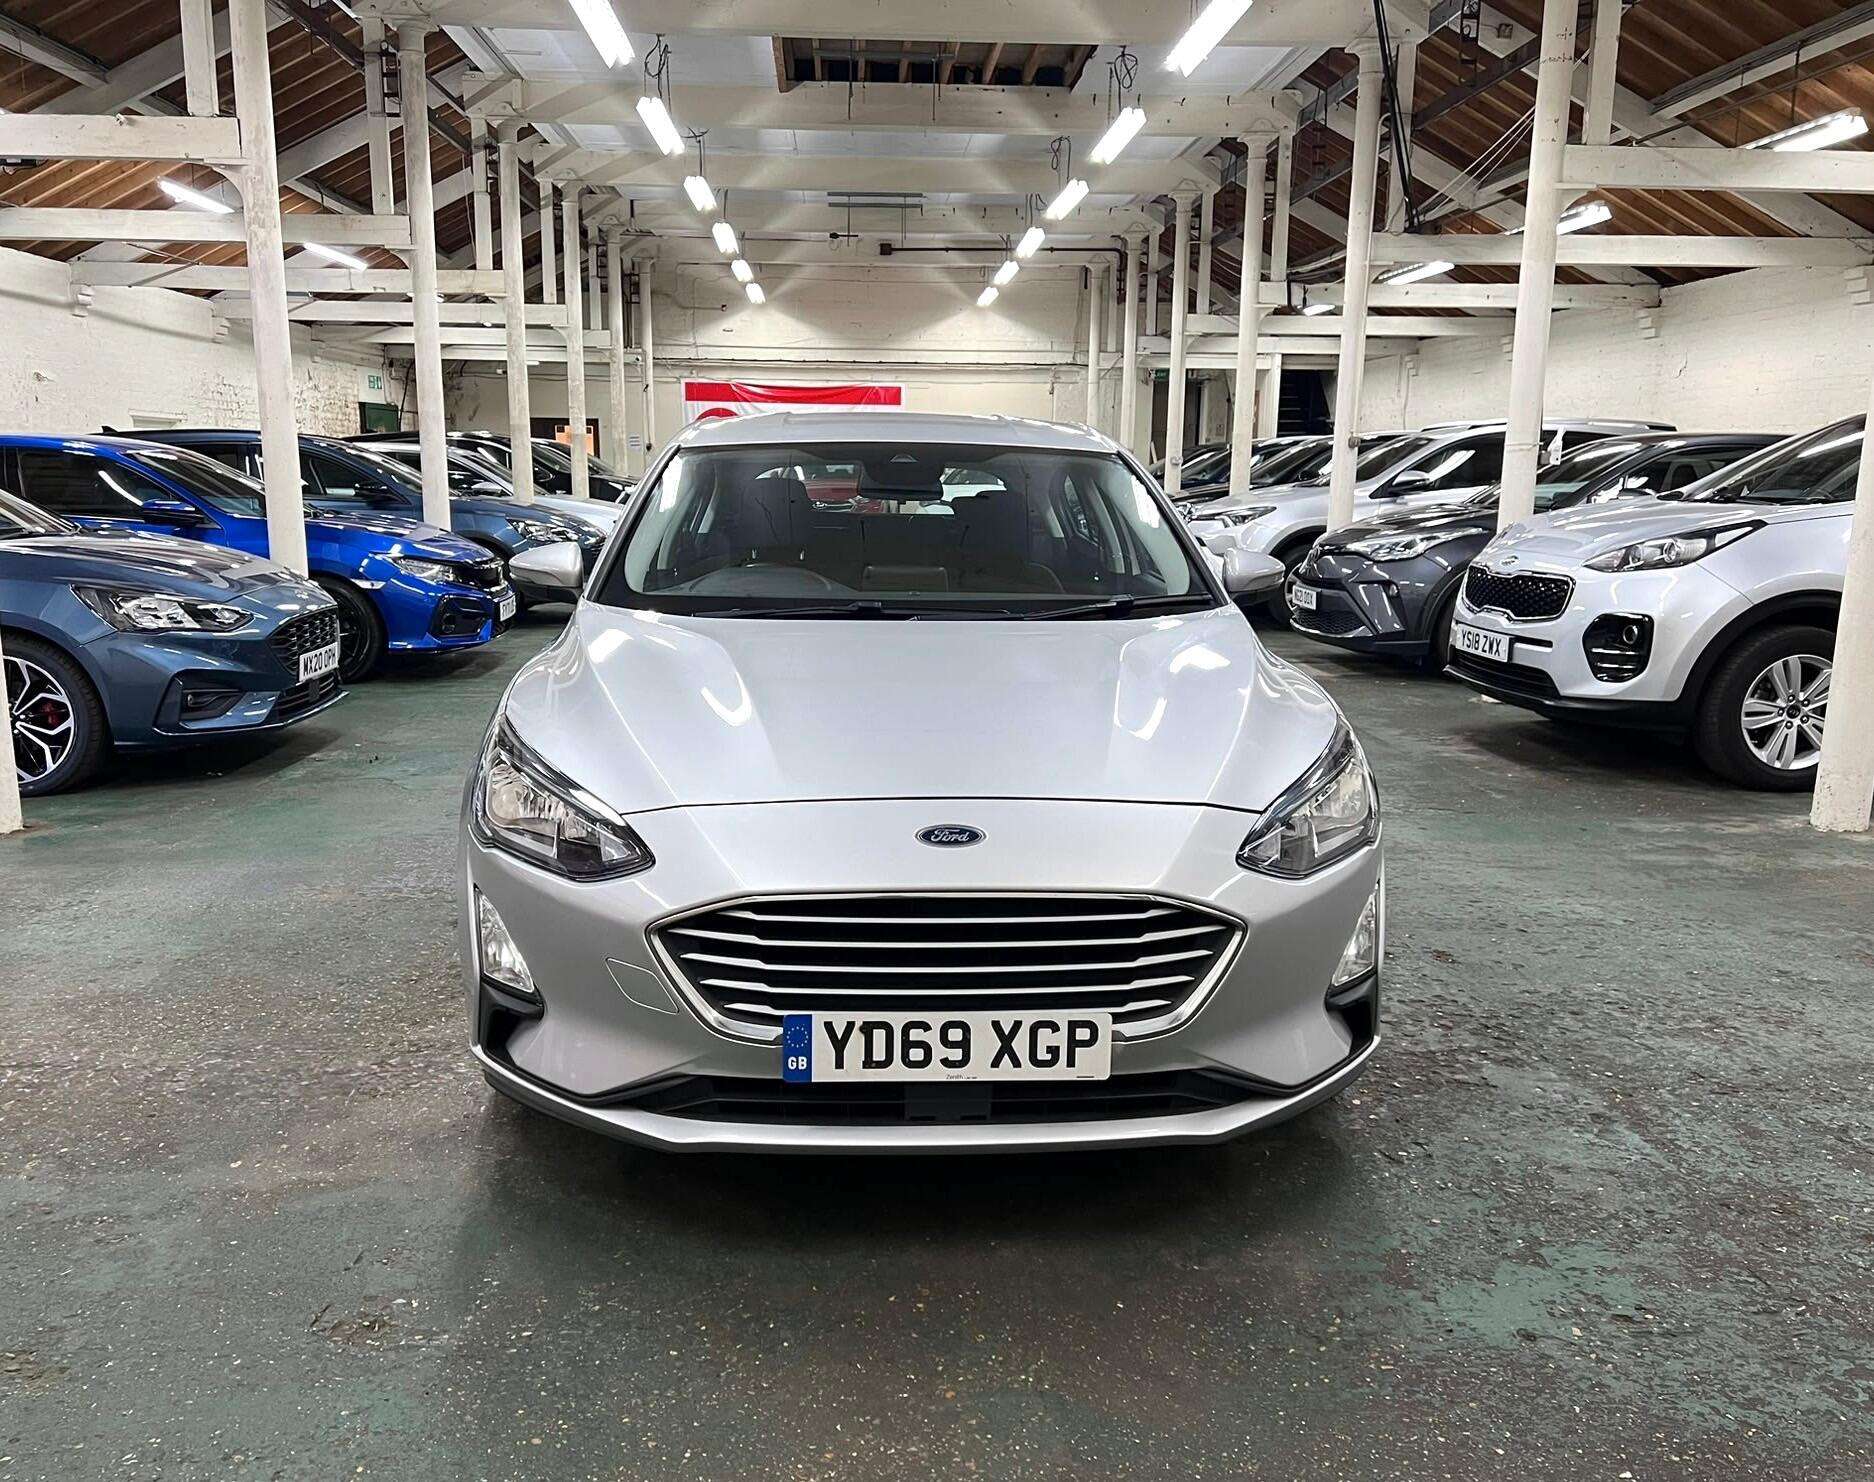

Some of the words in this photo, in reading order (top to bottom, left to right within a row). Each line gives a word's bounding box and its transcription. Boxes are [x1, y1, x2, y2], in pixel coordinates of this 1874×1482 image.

[1461, 629, 1481, 651] YS18
[1481, 634, 1502, 657] ZWX
[303, 650, 323, 677] MX20
[930, 827, 970, 842] Ford
[823, 1020, 972, 1070] YD69
[989, 1019, 1100, 1069] XGP
[787, 1056, 808, 1070] GB
